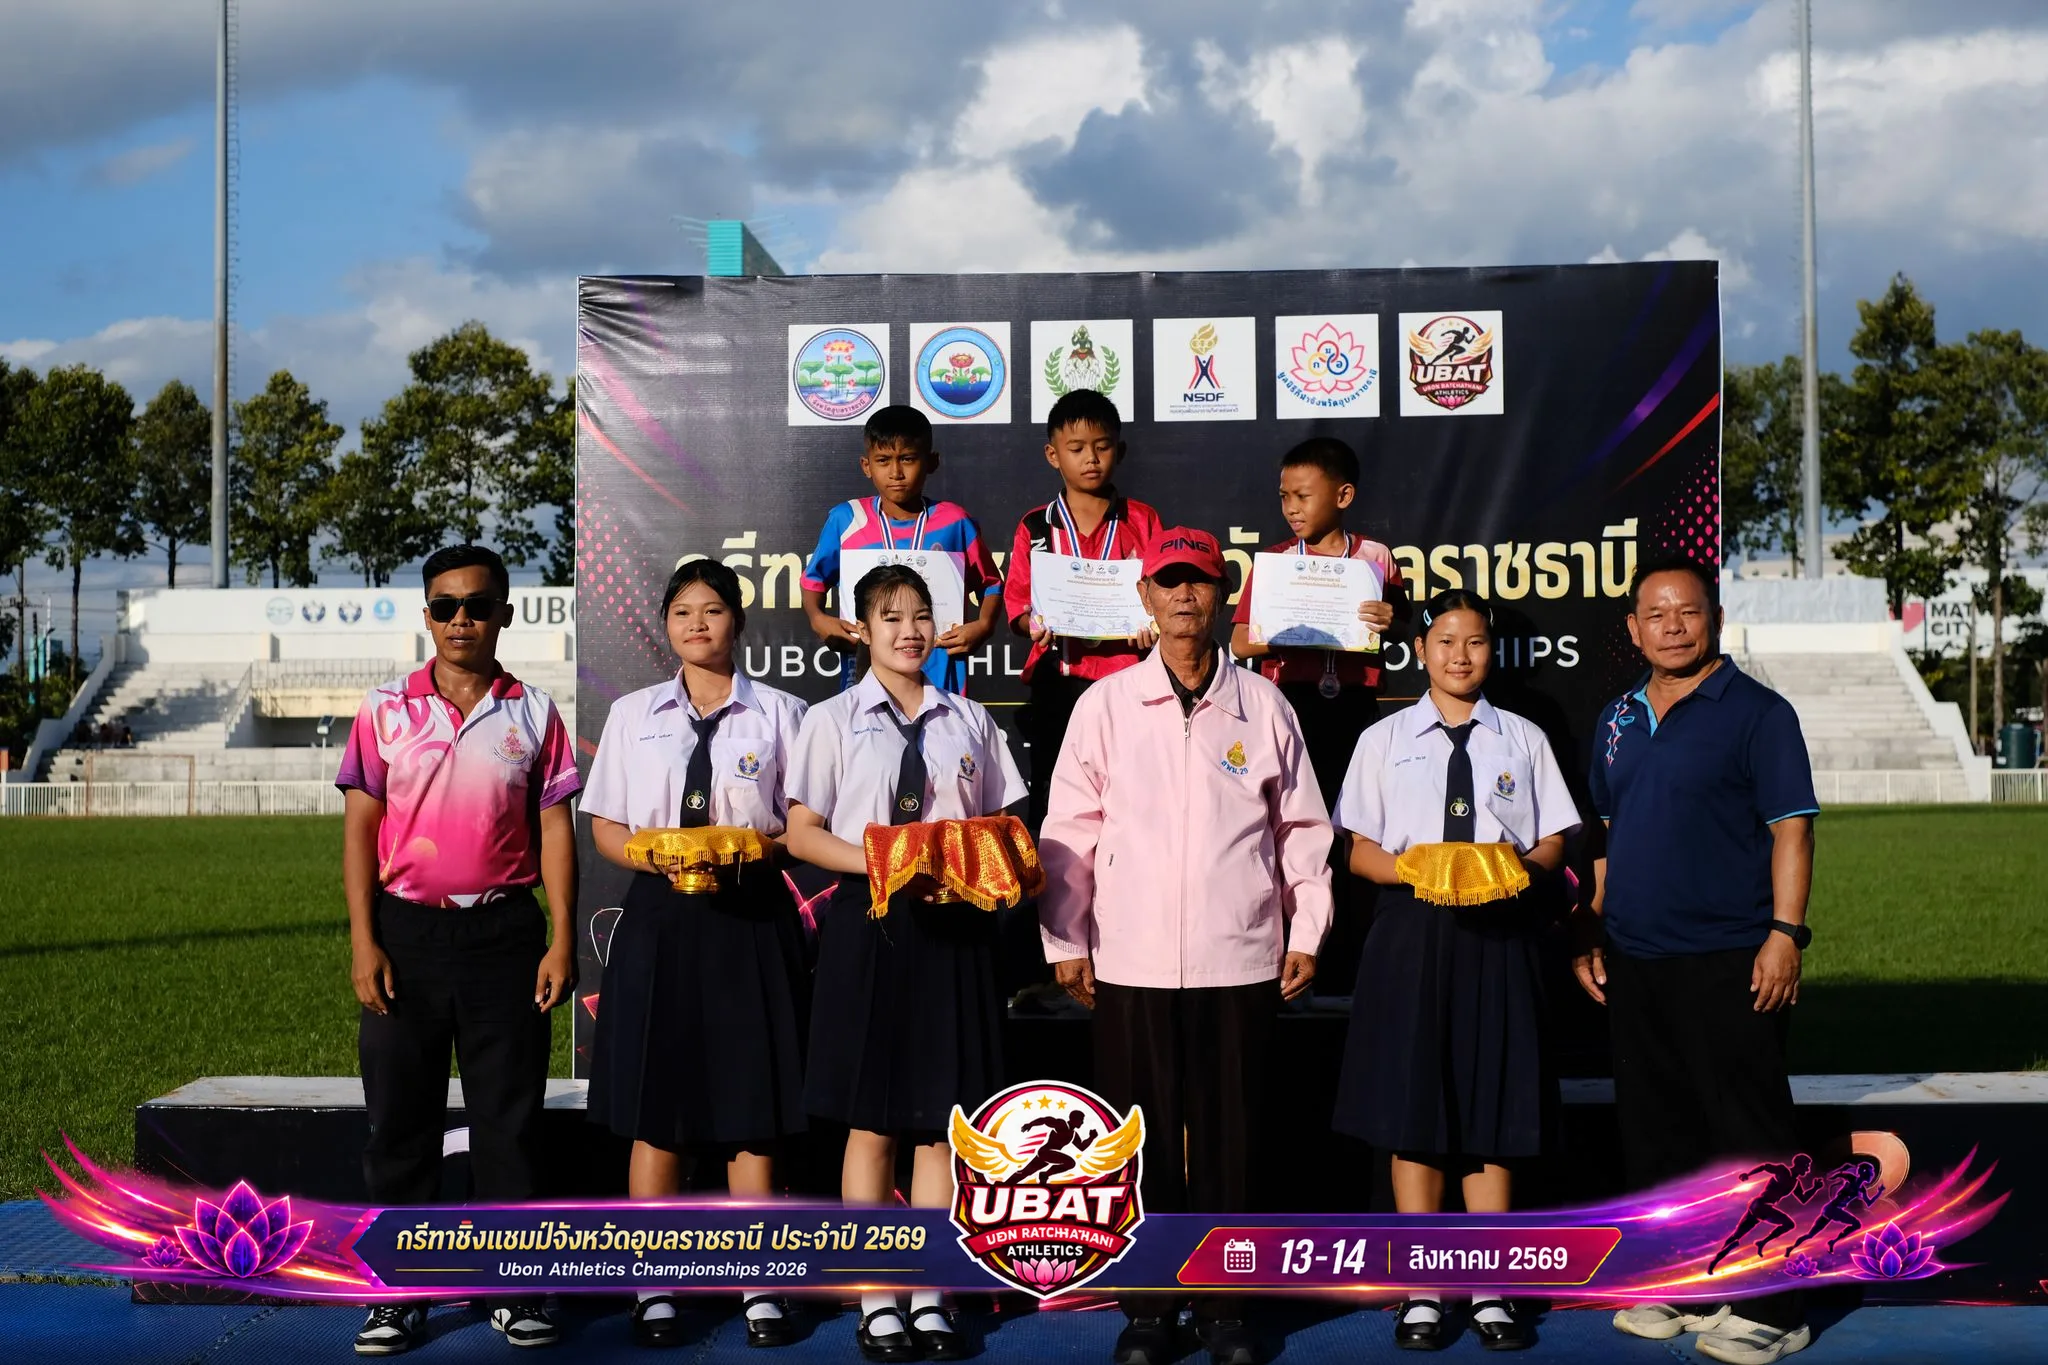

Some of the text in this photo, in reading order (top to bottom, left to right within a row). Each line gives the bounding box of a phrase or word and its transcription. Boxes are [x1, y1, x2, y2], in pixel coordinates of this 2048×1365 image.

[1415, 364, 1488, 384] UBAT
[1183, 392, 1225, 402] NSDF
[1159, 537, 1211, 555] PING
[522, 596, 575, 625] UB
